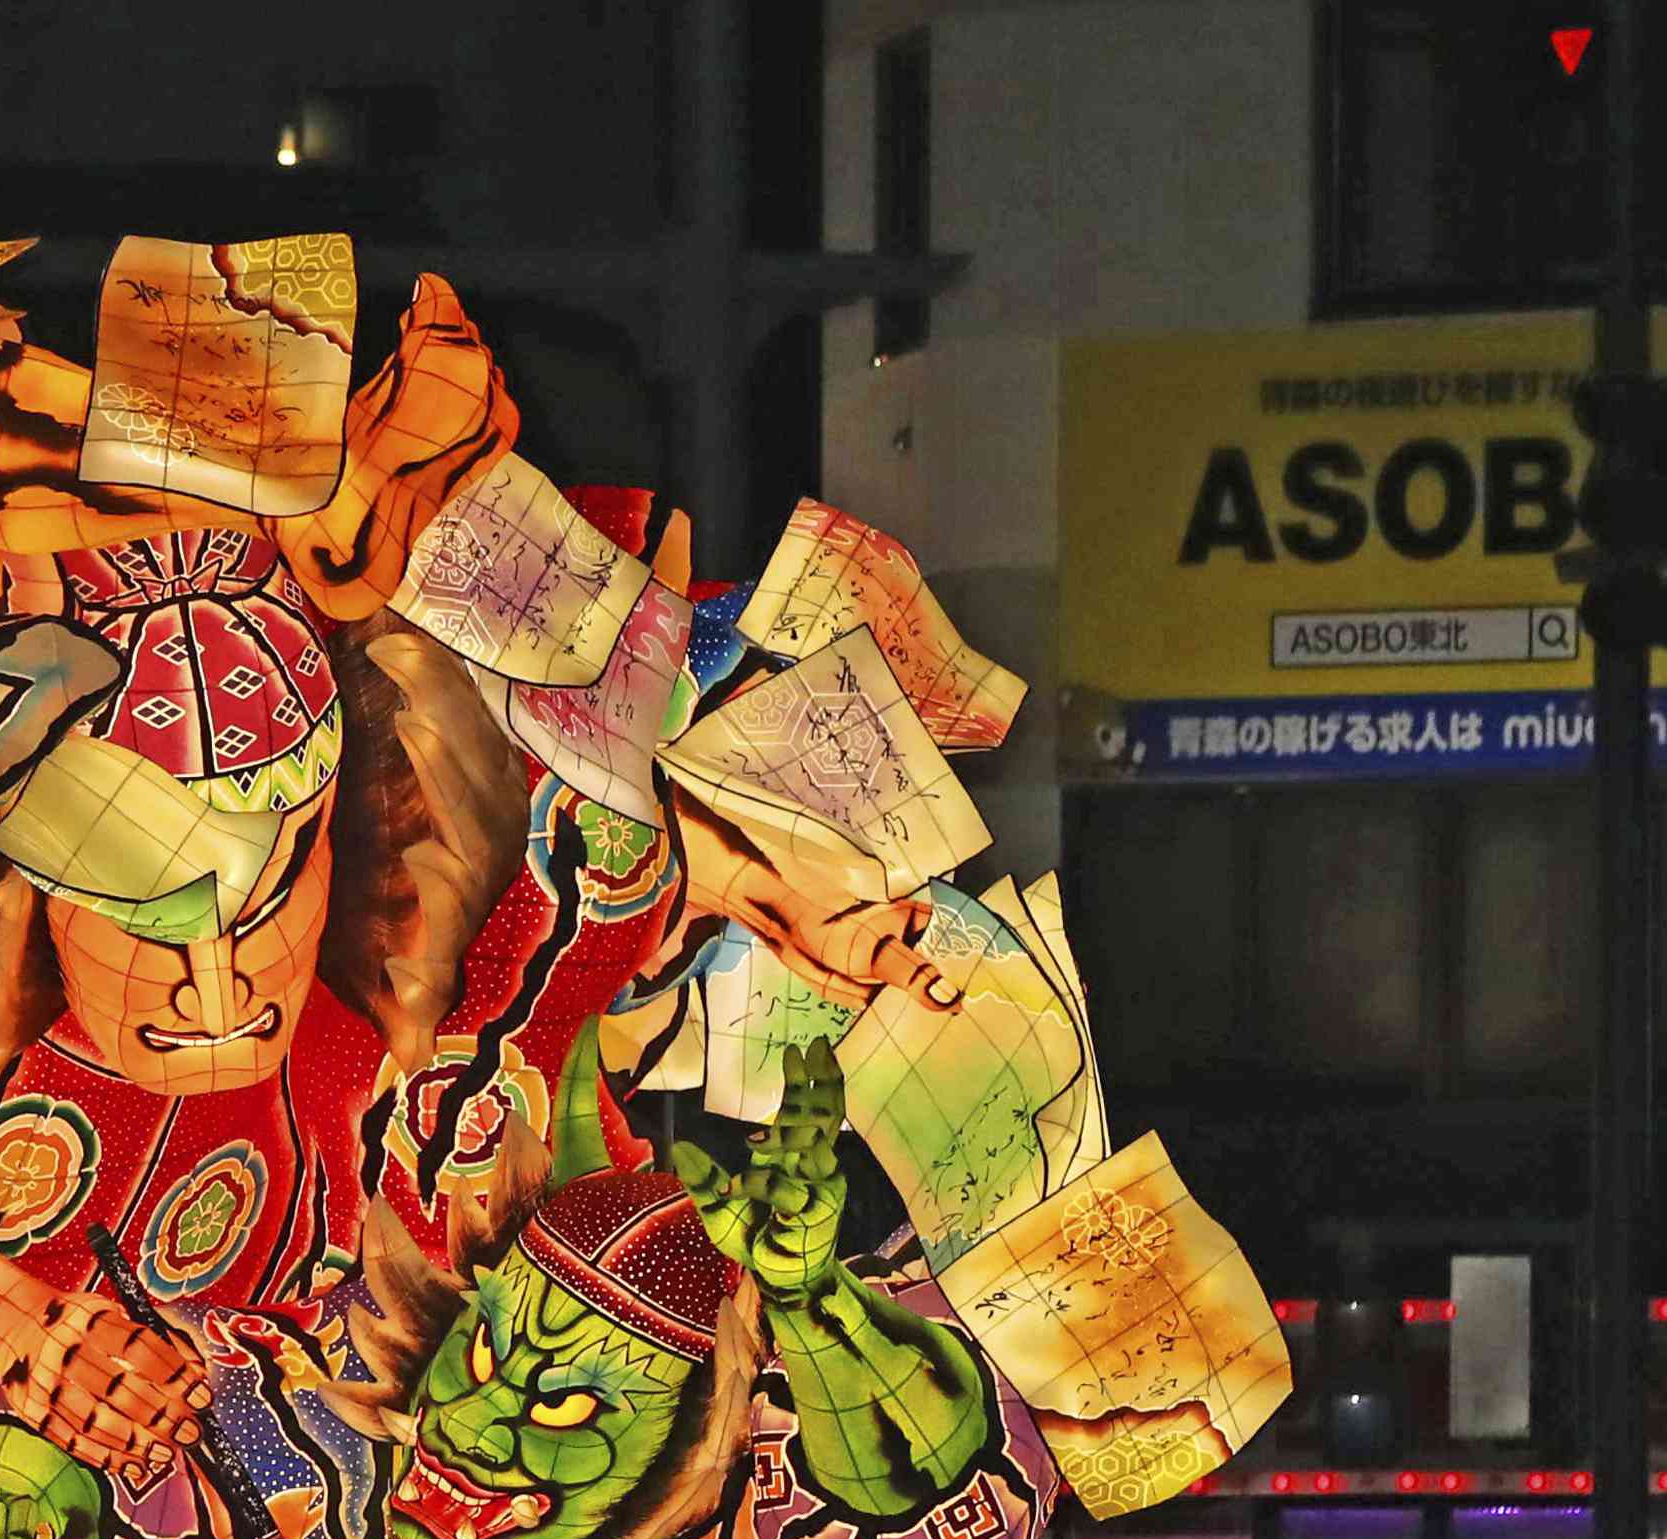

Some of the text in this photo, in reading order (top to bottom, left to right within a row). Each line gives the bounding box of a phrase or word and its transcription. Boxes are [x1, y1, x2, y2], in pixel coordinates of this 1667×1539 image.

[1177, 434, 1586, 567] ASOB
[1289, 612, 1470, 657] ASOBO東北
[1168, 709, 1484, 759] 青森の稼げる求人は
